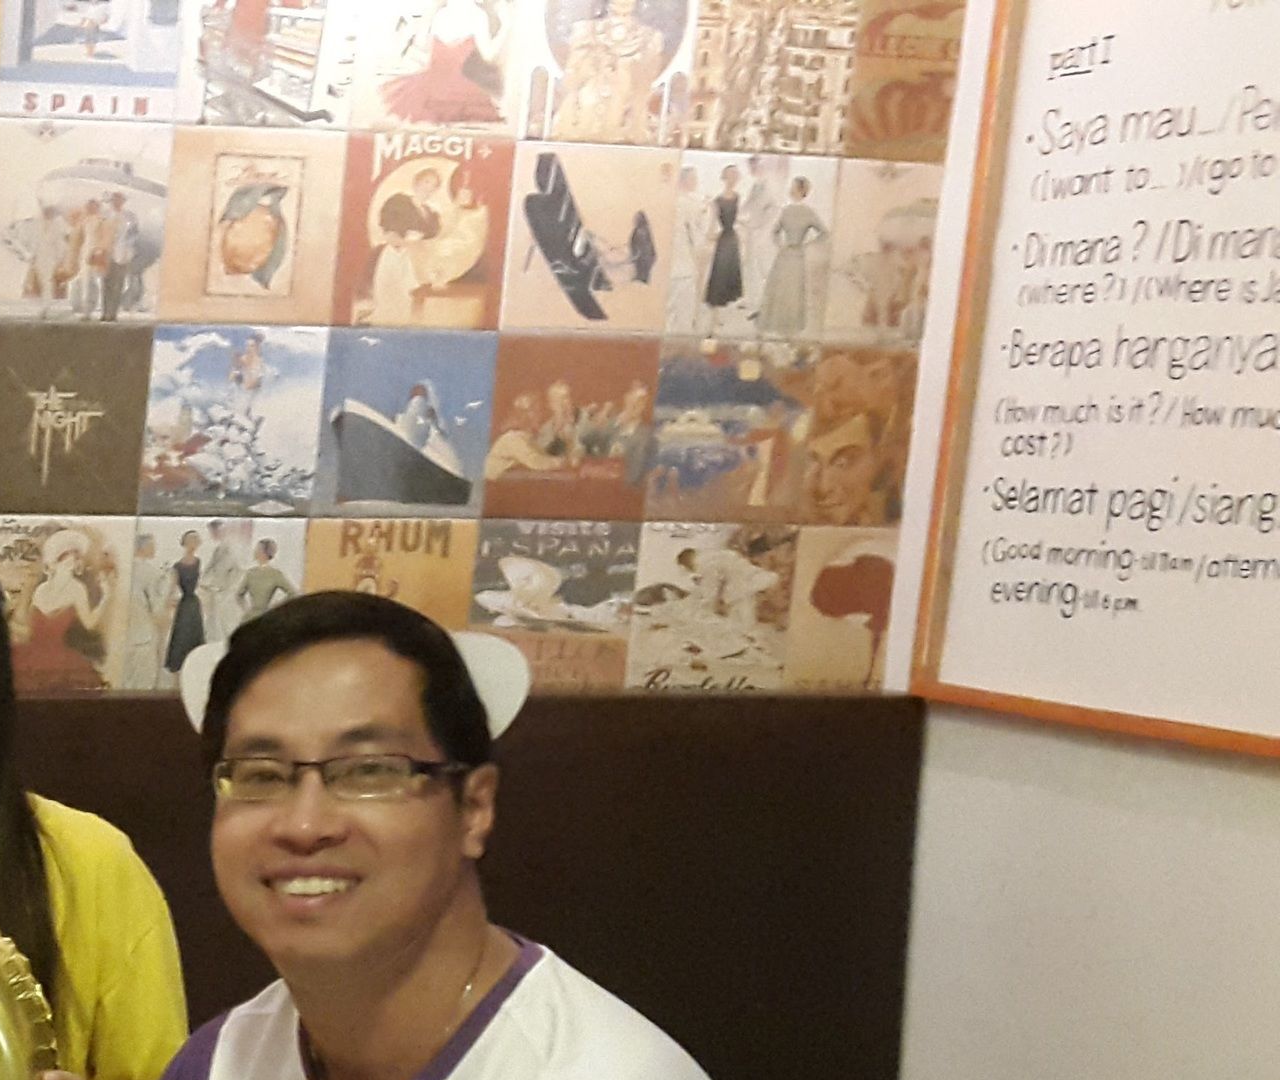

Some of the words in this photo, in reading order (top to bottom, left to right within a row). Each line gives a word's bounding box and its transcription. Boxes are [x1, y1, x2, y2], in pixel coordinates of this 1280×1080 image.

[22, 91, 147, 116] SPAIN
[370, 132, 473, 183] MAGGI
[991, 475, 1100, 515] Selamat
